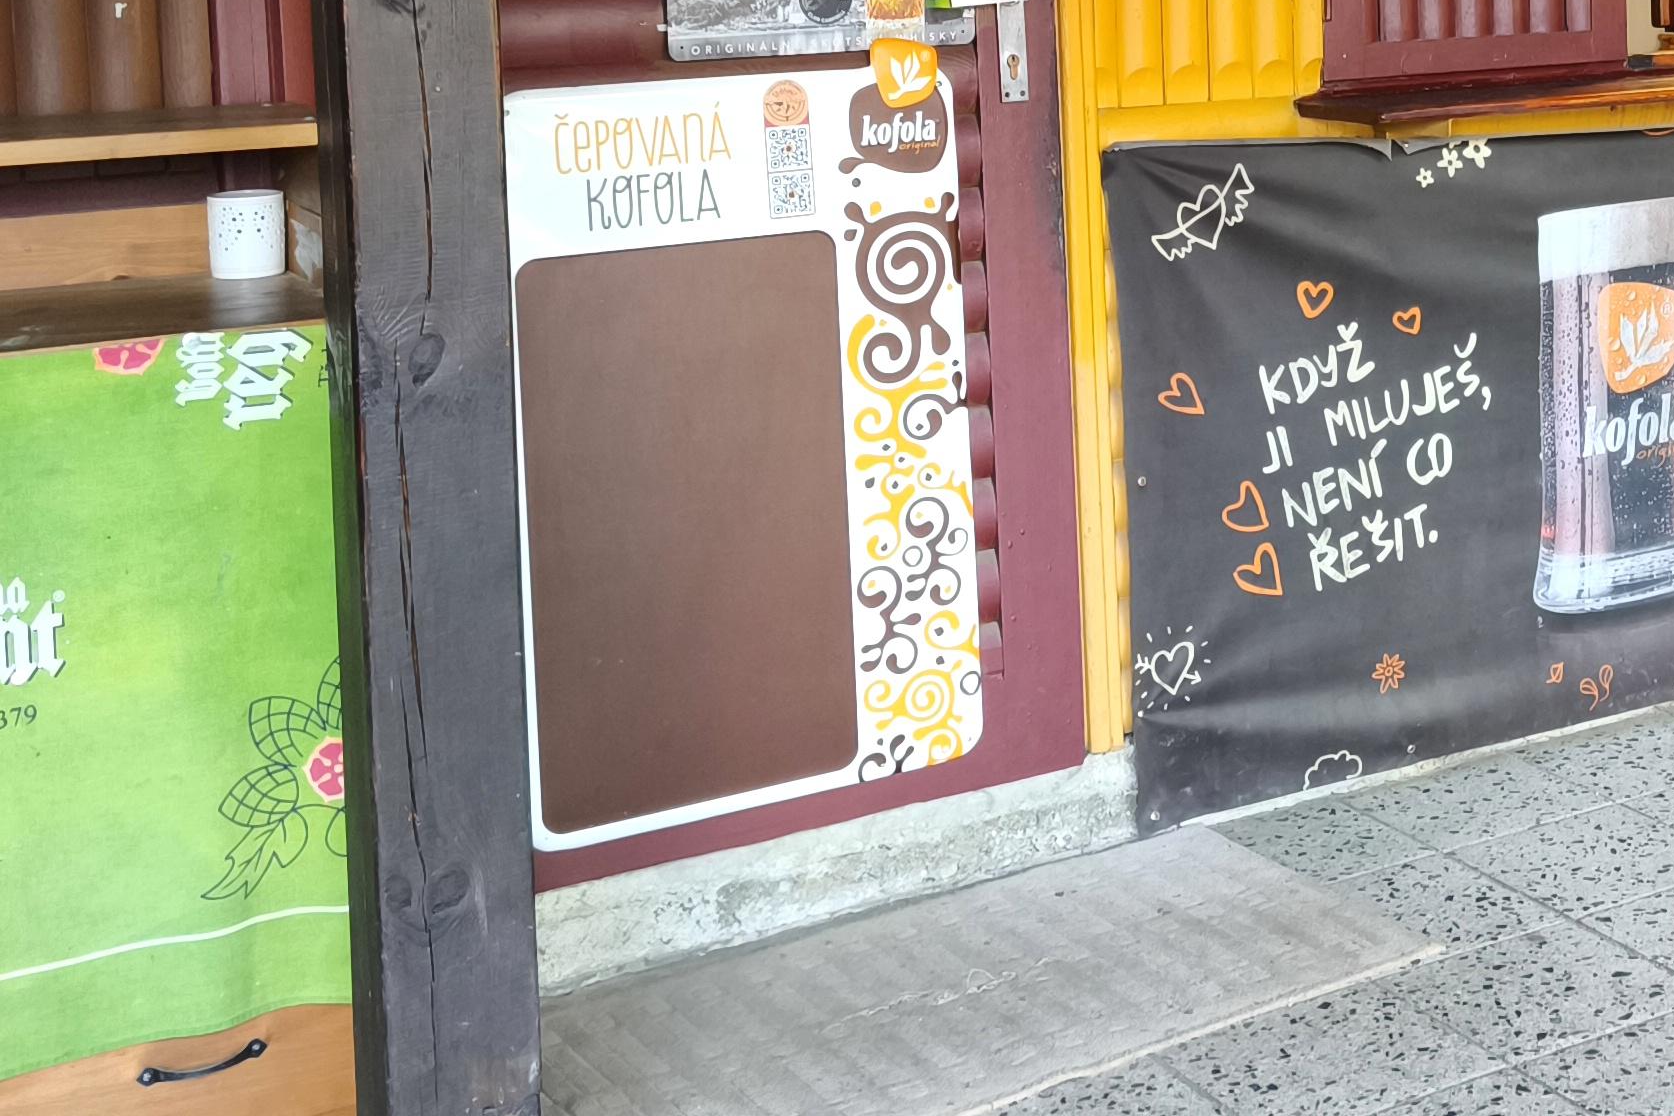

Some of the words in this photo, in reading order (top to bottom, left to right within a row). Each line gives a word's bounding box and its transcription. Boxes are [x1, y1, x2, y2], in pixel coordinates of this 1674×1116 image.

[860, 110, 937, 154] kofola
[899, 137, 941, 155] original
[586, 168, 722, 232] KOFOLA
[1258, 322, 1376, 415] KDYŽ
[1262, 426, 1295, 475] JI
[1323, 332, 1493, 448] MILUJEŠ,
[1280, 438, 1387, 528] NENÍ
[1406, 432, 1453, 487] CO
[1309, 503, 1440, 593] ŘEŠIT.
